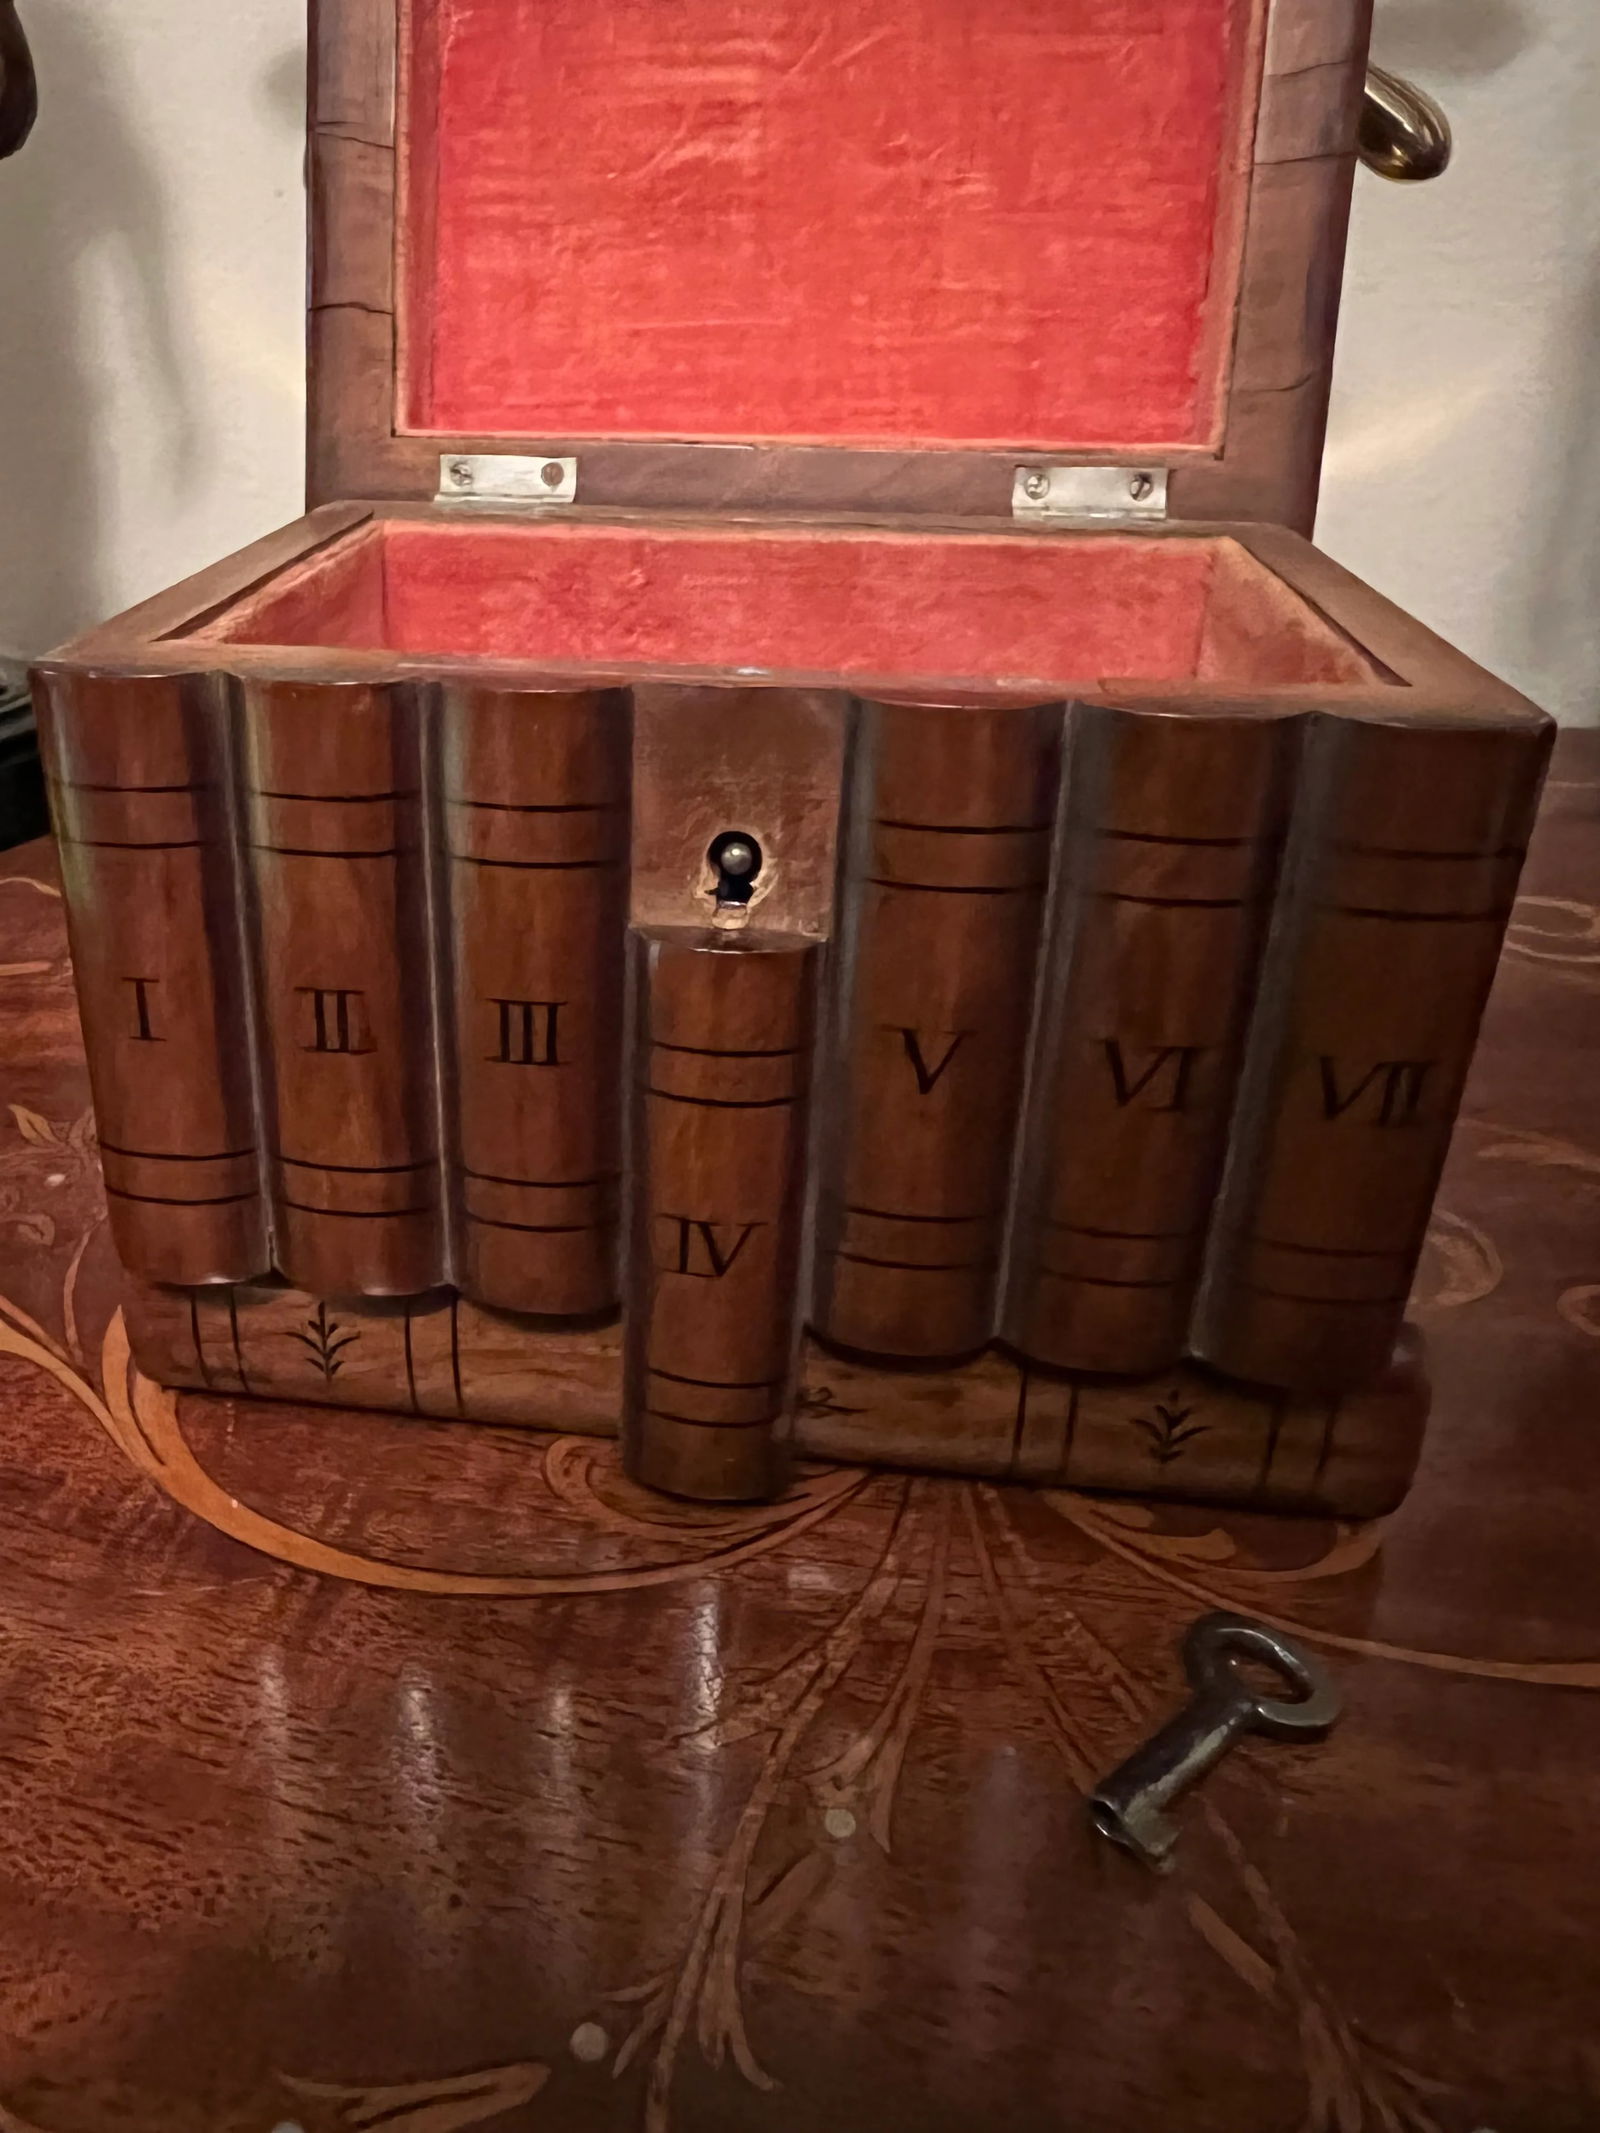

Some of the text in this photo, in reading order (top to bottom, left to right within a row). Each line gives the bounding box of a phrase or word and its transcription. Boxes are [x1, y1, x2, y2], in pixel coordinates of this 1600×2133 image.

[123, 977, 165, 1042] I
[294, 987, 376, 1054] II
[484, 998, 566, 1065] III
[884, 1027, 975, 1093] V
[1095, 1037, 1204, 1113] VI
[1313, 1052, 1436, 1126] VII
[652, 1213, 767, 1278] IV
